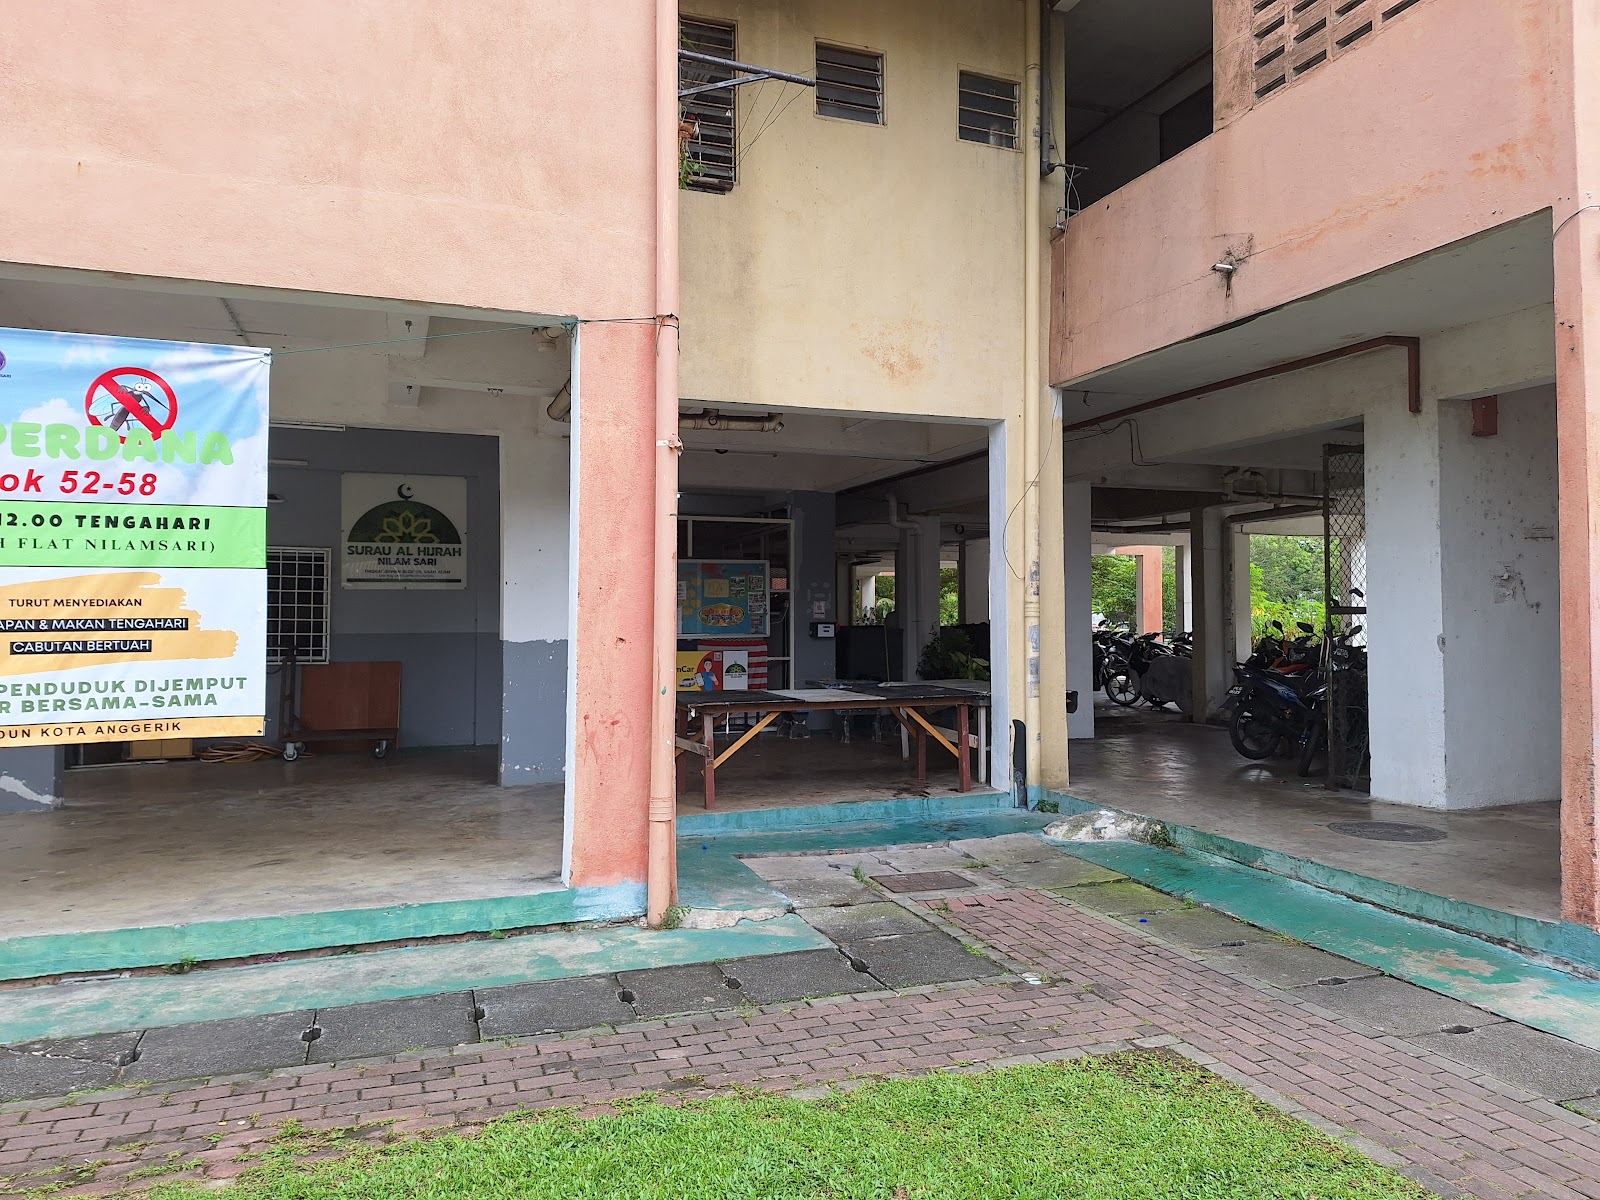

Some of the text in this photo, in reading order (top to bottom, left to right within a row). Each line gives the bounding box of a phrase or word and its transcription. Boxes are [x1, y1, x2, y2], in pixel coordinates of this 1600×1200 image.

[0, 422, 234, 466] ERDANA
[59, 471, 158, 496] 52-58
[0, 512, 211, 530] 2.00 TENGAHARI
[18, 538, 74, 550] FLAT
[85, 539, 215, 553] NILAMSARI)
[347, 545, 392, 556] SURAU
[396, 546, 413, 556] AL
[378, 557, 437, 566] NILAM SARI
[9, 598, 142, 607] TURUT MENYEDIAKAN
[39, 619, 49, 630] &
[52, 619, 105, 630] MAKAN
[108, 618, 187, 629] TENGAHARI
[12, 640, 150, 653] CABUTAN BERTUAH
[134, 677, 248, 693] DIJEMPUT
[21, 693, 218, 713] BERSAMA-SAMA
[41, 726, 87, 737] KOTA
[95, 722, 181, 735] ANGGERIK
